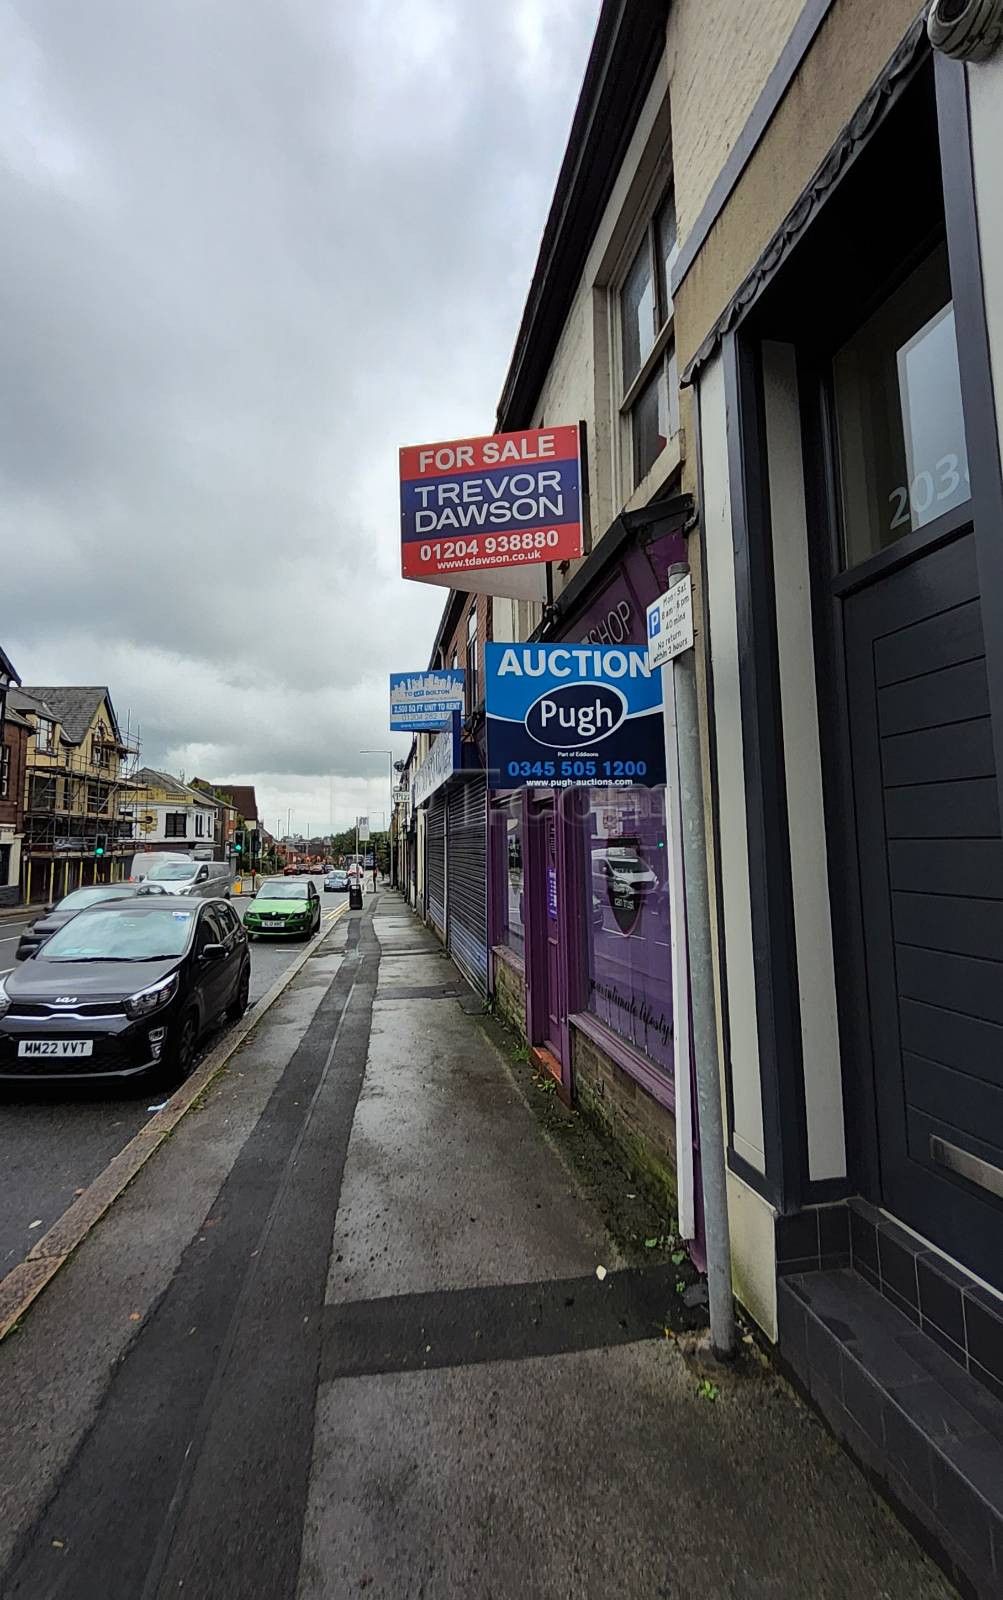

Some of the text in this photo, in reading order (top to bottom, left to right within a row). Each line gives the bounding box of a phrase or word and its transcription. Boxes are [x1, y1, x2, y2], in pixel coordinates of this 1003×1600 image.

[419, 435, 556, 473] FOR SALE
[414, 470, 562, 508] TREVOR
[889, 453, 970, 531] 203
[415, 494, 564, 533] DAWSON
[420, 530, 559, 561] 01204 938880
[437, 550, 542, 570] www.tdawson.co.uk
[677, 582, 687, 596] Sat
[650, 610, 660, 636] P
[674, 612, 686, 626] mins
[665, 630, 682, 646] return
[673, 637, 688, 652] hours
[497, 649, 652, 678] AUCTION
[424, 703, 437, 711] UNIT
[438, 703, 446, 711] TO
[540, 698, 613, 737] Pugh
[507, 761, 647, 777] 0345 505 1200
[526, 778, 633, 788] www.pugh-auctions.com
[24, 1041, 87, 1055] MM22 VVT
